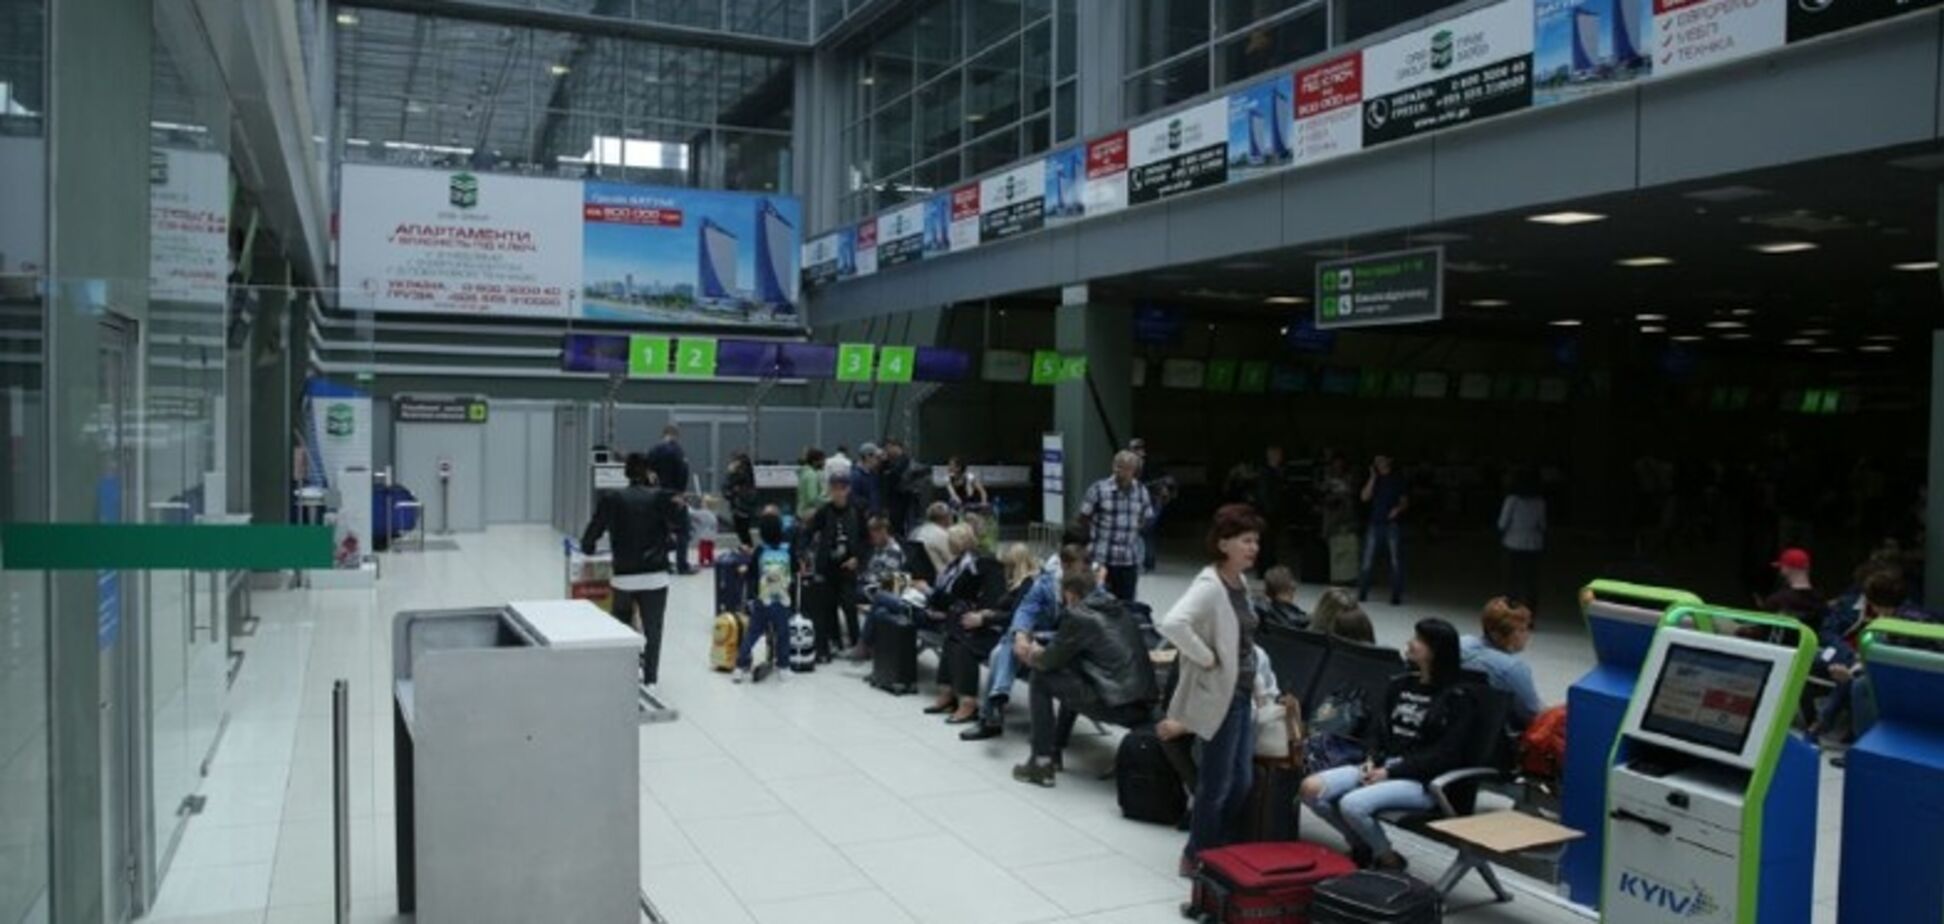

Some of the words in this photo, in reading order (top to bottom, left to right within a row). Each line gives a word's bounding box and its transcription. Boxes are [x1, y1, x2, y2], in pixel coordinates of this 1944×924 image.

[395, 224, 532, 242] АПАРТАМЕНТИ
[643, 345, 653, 366] 1
[689, 348, 703, 368] 2
[848, 353, 861, 373] 3
[889, 355, 902, 374] 4
[1042, 359, 1054, 376] 5
[1619, 872, 1690, 914] KYIV
